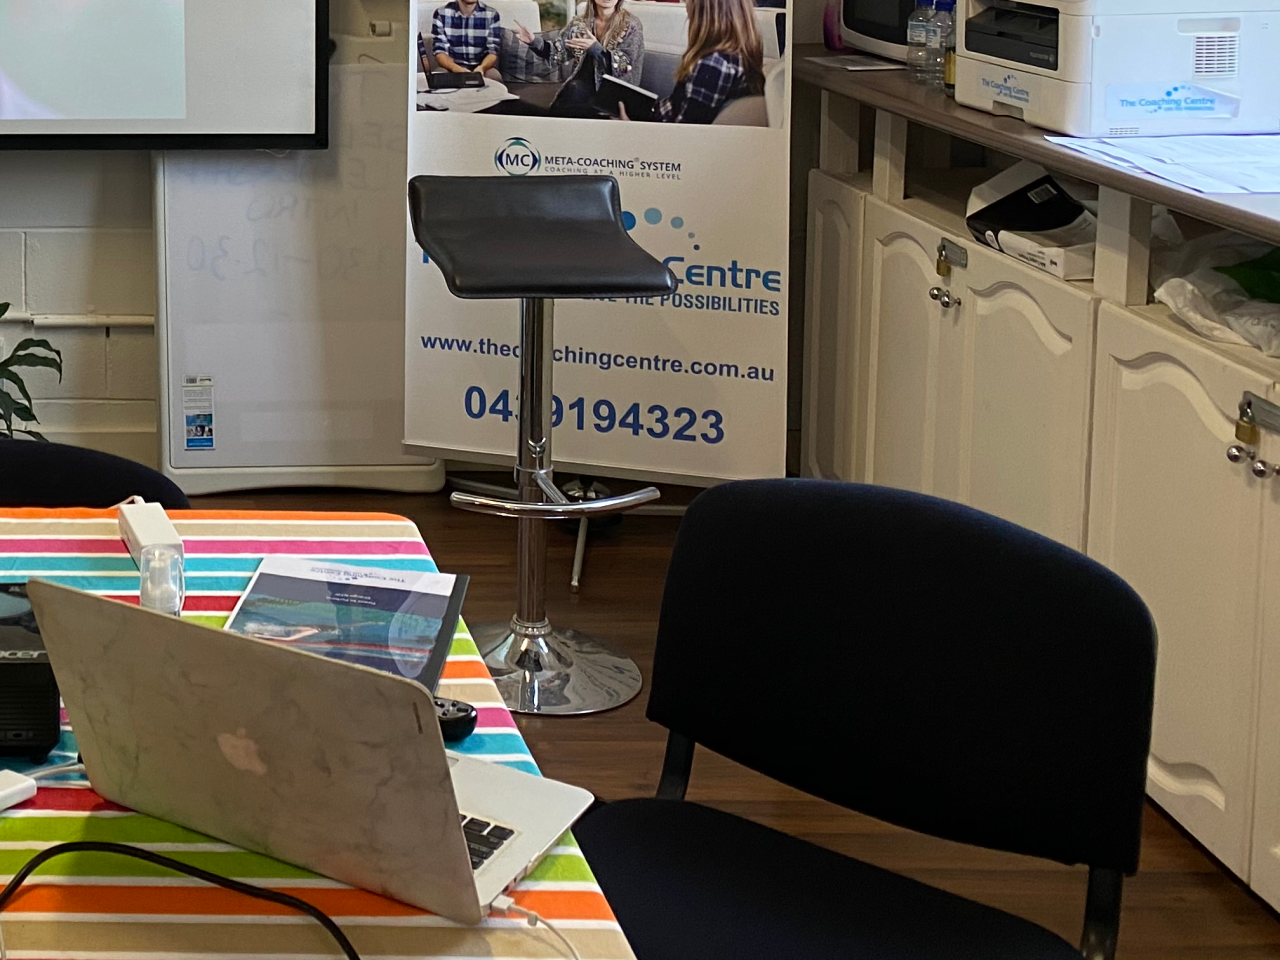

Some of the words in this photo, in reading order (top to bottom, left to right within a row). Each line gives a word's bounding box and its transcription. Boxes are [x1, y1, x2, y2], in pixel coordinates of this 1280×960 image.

[505, 153, 531, 167] MC
[640, 161, 681, 172] SYSTEM
[545, 167, 588, 175] COACHING
[620, 170, 651, 178] HIGHER
[660, 294, 780, 316] POSSIBILITIES
[421, 335, 774, 382] www.thecchingcentre.com.au
[464, 385, 725, 444] 049194323
